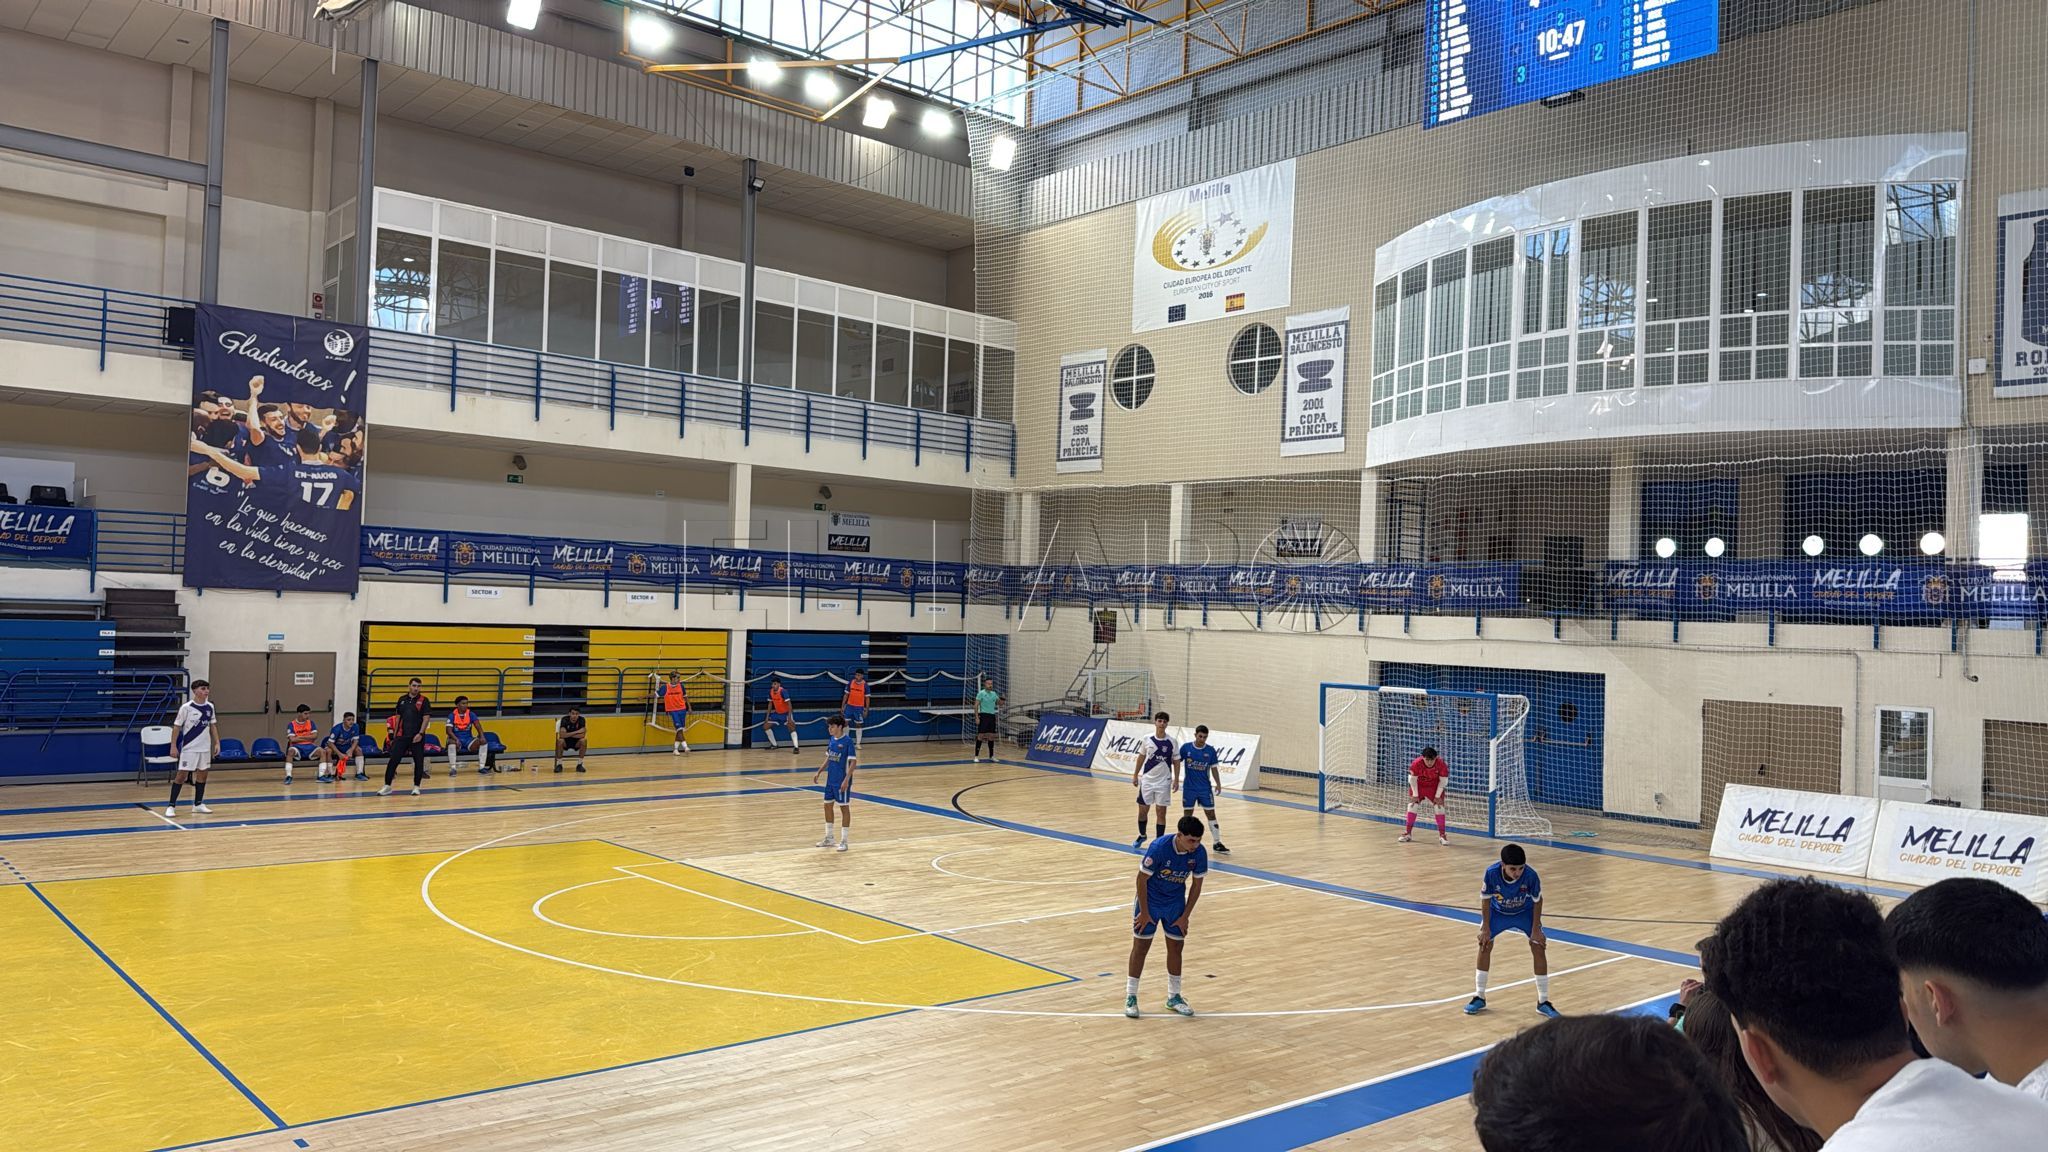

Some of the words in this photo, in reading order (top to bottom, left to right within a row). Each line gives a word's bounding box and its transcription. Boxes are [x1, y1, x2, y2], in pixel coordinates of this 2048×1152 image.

[1557, 12, 1564, 26] 2
[1537, 20, 1585, 55] 10:47
[1594, 43, 1604, 61] 2
[1517, 66, 1526, 83] 3
[1189, 182, 1232, 204] Melilla
[1163, 279, 1184, 290] CIUDAD
[1185, 273, 1211, 285] EUROPEA
[1212, 271, 1223, 279] DEL
[1224, 265, 1252, 277] DEPORTE
[1198, 290, 1214, 300] 2016
[1292, 326, 1340, 344] MELILLA
[1290, 337, 1343, 355] BALONCESTO
[218, 330, 334, 391] Gladiadores
[1066, 366, 1101, 378] MELILLA
[1064, 374, 1102, 388] BALONCESTO
[1302, 398, 1324, 411] 2001
[1299, 411, 1327, 425] COPA
[1288, 422, 1338, 437] PRINCIPE
[1070, 437, 1091, 447] COPA
[1062, 446, 1098, 457] PRINCIPE
[301, 482, 334, 506] 17
[256, 509, 279, 527] que
[280, 513, 328, 543] hacemos
[842, 518, 870, 528] MELILLA
[33, 535, 68, 545] DEPORTE
[205, 511, 224, 526] en
[227, 513, 243, 532] la
[245, 526, 271, 544] vida
[274, 535, 304, 556] tiene
[306, 551, 320, 563] su
[321, 557, 345, 571] eco
[368, 533, 439, 553] MELILLA
[830, 535, 868, 547] MELILLA
[219, 540, 238, 554] en
[241, 541, 256, 560] la
[552, 544, 614, 563] MELILLA
[482, 551, 542, 567] MELILLA
[710, 554, 762, 572] MELILLA
[651, 562, 700, 575] MELILLA
[794, 568, 836, 581] MELILLA
[844, 561, 891, 577] MELILLA
[918, 575, 956, 586] MELILLA
[1359, 571, 1415, 588] MELILLA
[1607, 568, 1679, 588] MELILLA
[1812, 568, 1901, 589] MELILLA
[1305, 582, 1350, 595] MELILLA
[1451, 584, 1506, 597] MELILLA
[1727, 583, 1798, 598] MELILLA
[1961, 585, 2048, 602] MELILLA
[1037, 724, 1097, 748] MELILLA
[1739, 807, 1856, 843] MELILLA
[1738, 832, 1774, 845] CIUDAD
[1777, 836, 1796, 848] DEL
[1800, 840, 1844, 854] DEPORTE
[1900, 825, 2036, 864] MELILLA
[1899, 852, 1942, 866] CIUDAD
[1946, 858, 1967, 870] DEL
[1972, 862, 2023, 877] DEPORTE
